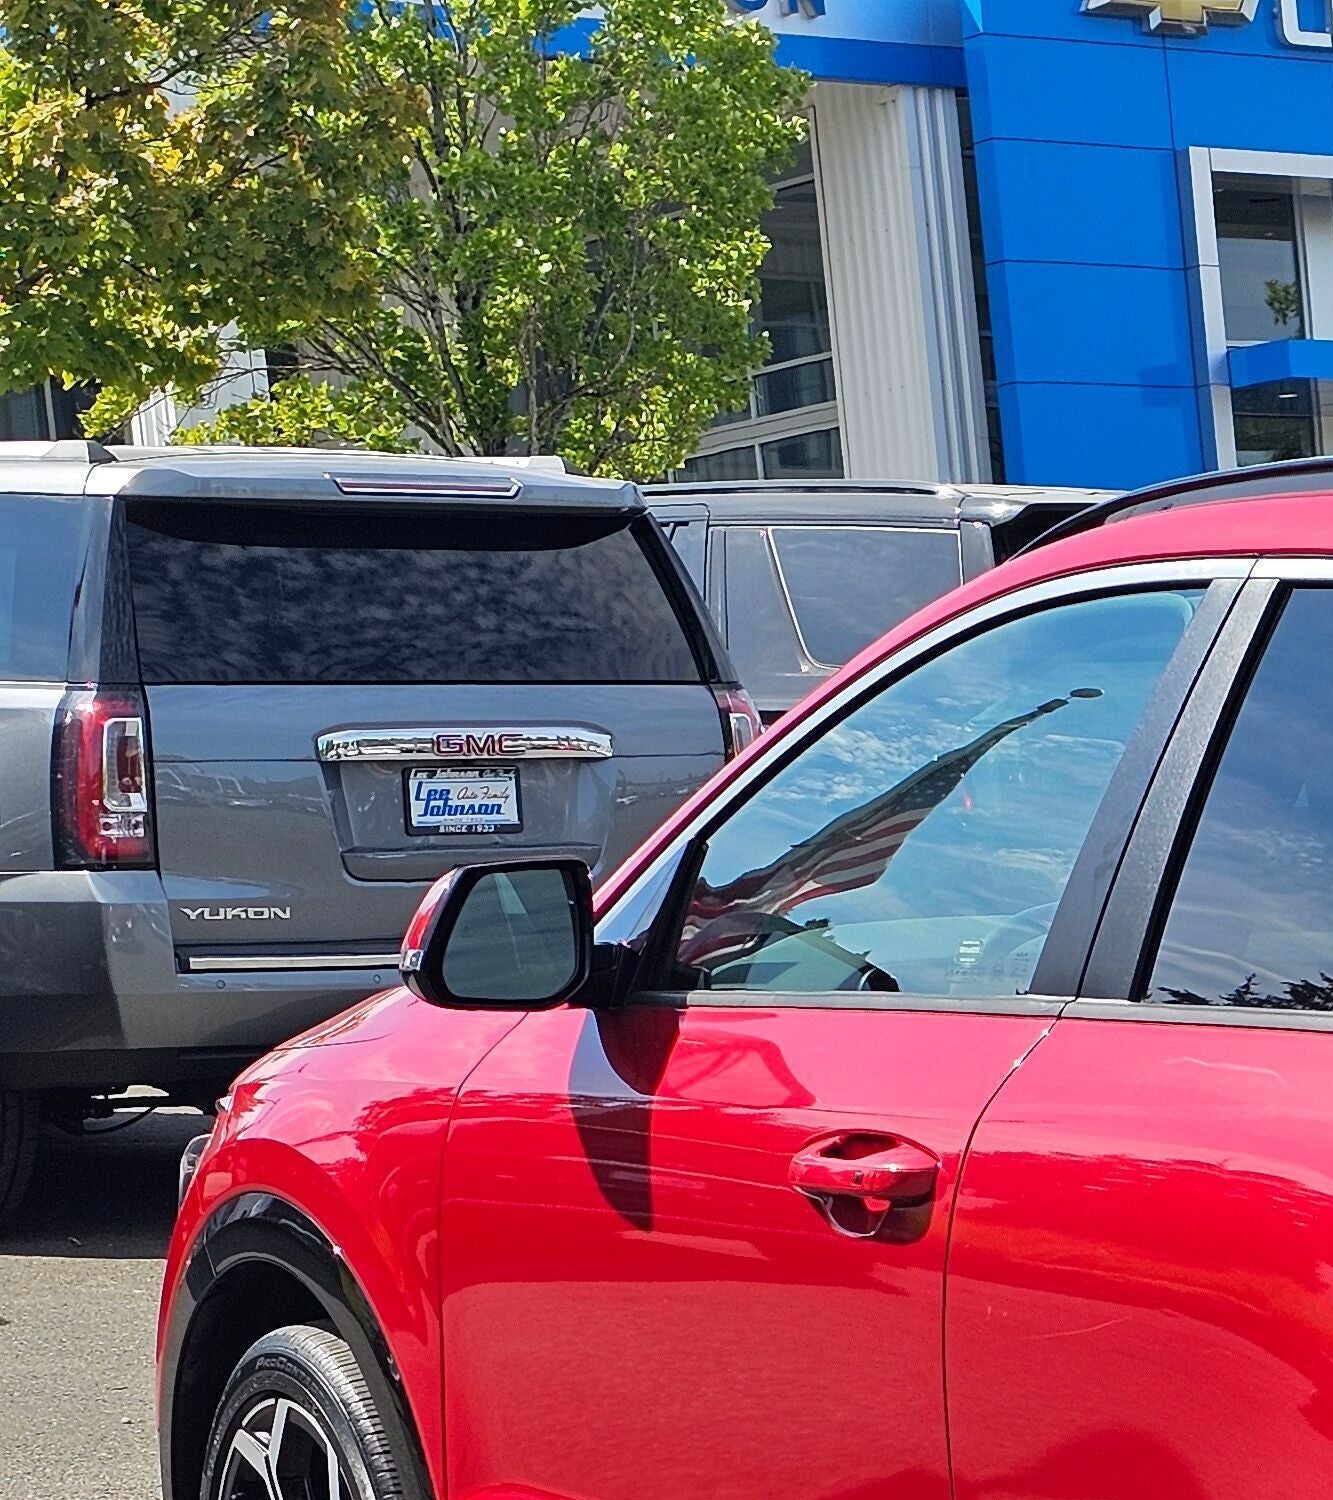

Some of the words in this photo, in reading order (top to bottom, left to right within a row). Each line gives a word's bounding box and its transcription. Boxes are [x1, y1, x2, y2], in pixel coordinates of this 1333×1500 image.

[434, 732, 525, 756] GMC
[415, 781, 453, 802] Lee
[417, 800, 505, 817] Johnson
[439, 824, 468, 833] SINCE
[471, 824, 495, 833] 1933
[179, 906, 291, 920] YUKON
